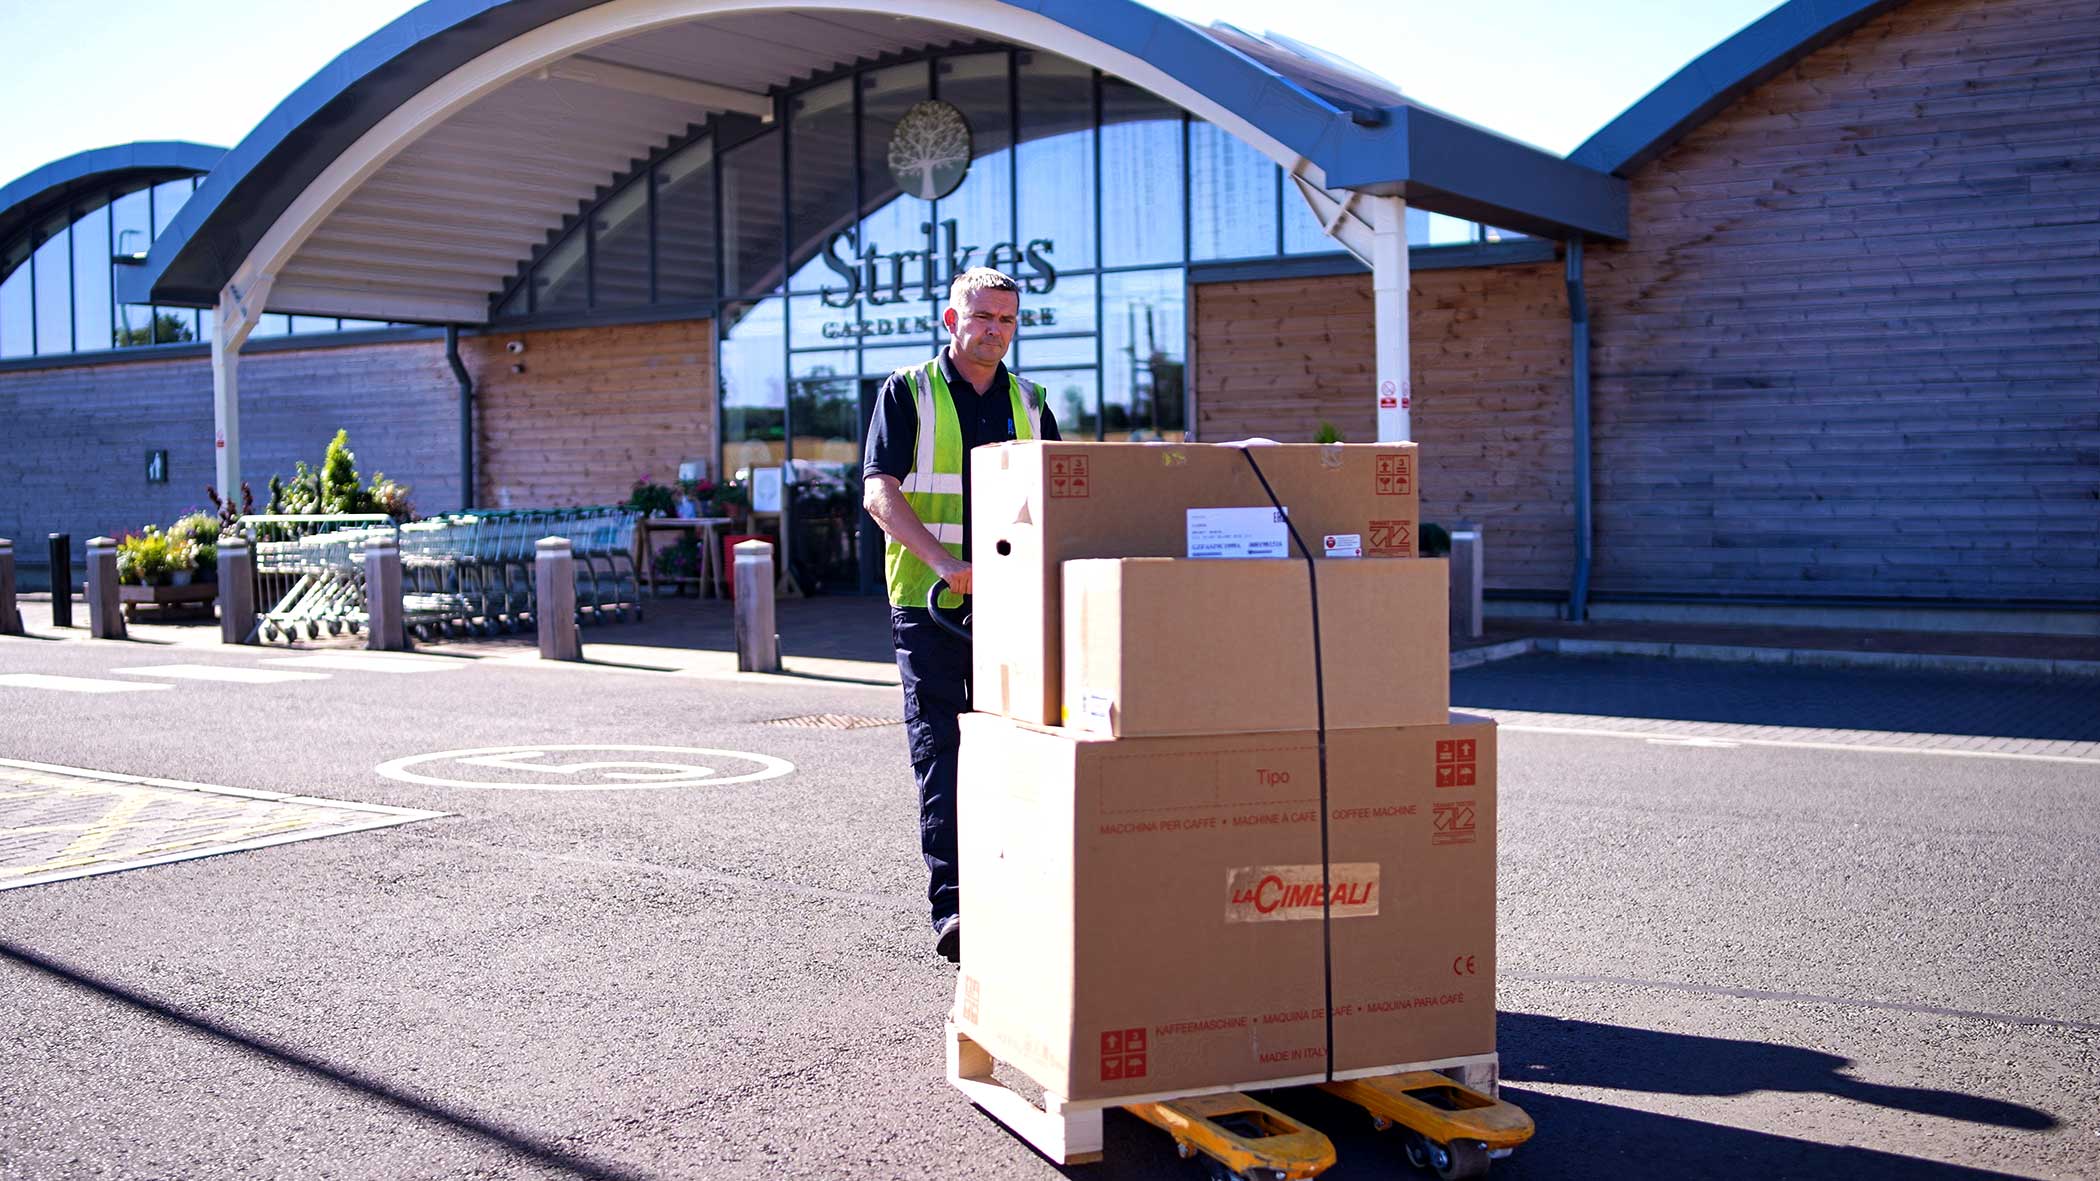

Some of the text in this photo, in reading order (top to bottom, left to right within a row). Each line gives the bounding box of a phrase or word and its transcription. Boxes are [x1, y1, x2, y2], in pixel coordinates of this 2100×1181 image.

[821, 218, 1057, 309] Strikes
[822, 315, 932, 339] GARDEN
[1256, 769, 1290, 787] Tipo
[1100, 822, 1159, 835] MACCHINA
[1160, 820, 1181, 832] PER
[1232, 813, 1280, 826] MACHINE
[1332, 808, 1371, 820] COFFEE
[1372, 805, 1417, 817] MACHINE
[1155, 1016, 1248, 1037] KAFFEEMASCHINE
[1262, 1009, 1309, 1025] MAQUINA
[1311, 1007, 1325, 1020] DE
[1367, 1000, 1412, 1014] MAQUINA
[1413, 996, 1439, 1009] PARA
[1259, 1050, 1289, 1064] MADE
[1291, 1048, 1302, 1060] IN
